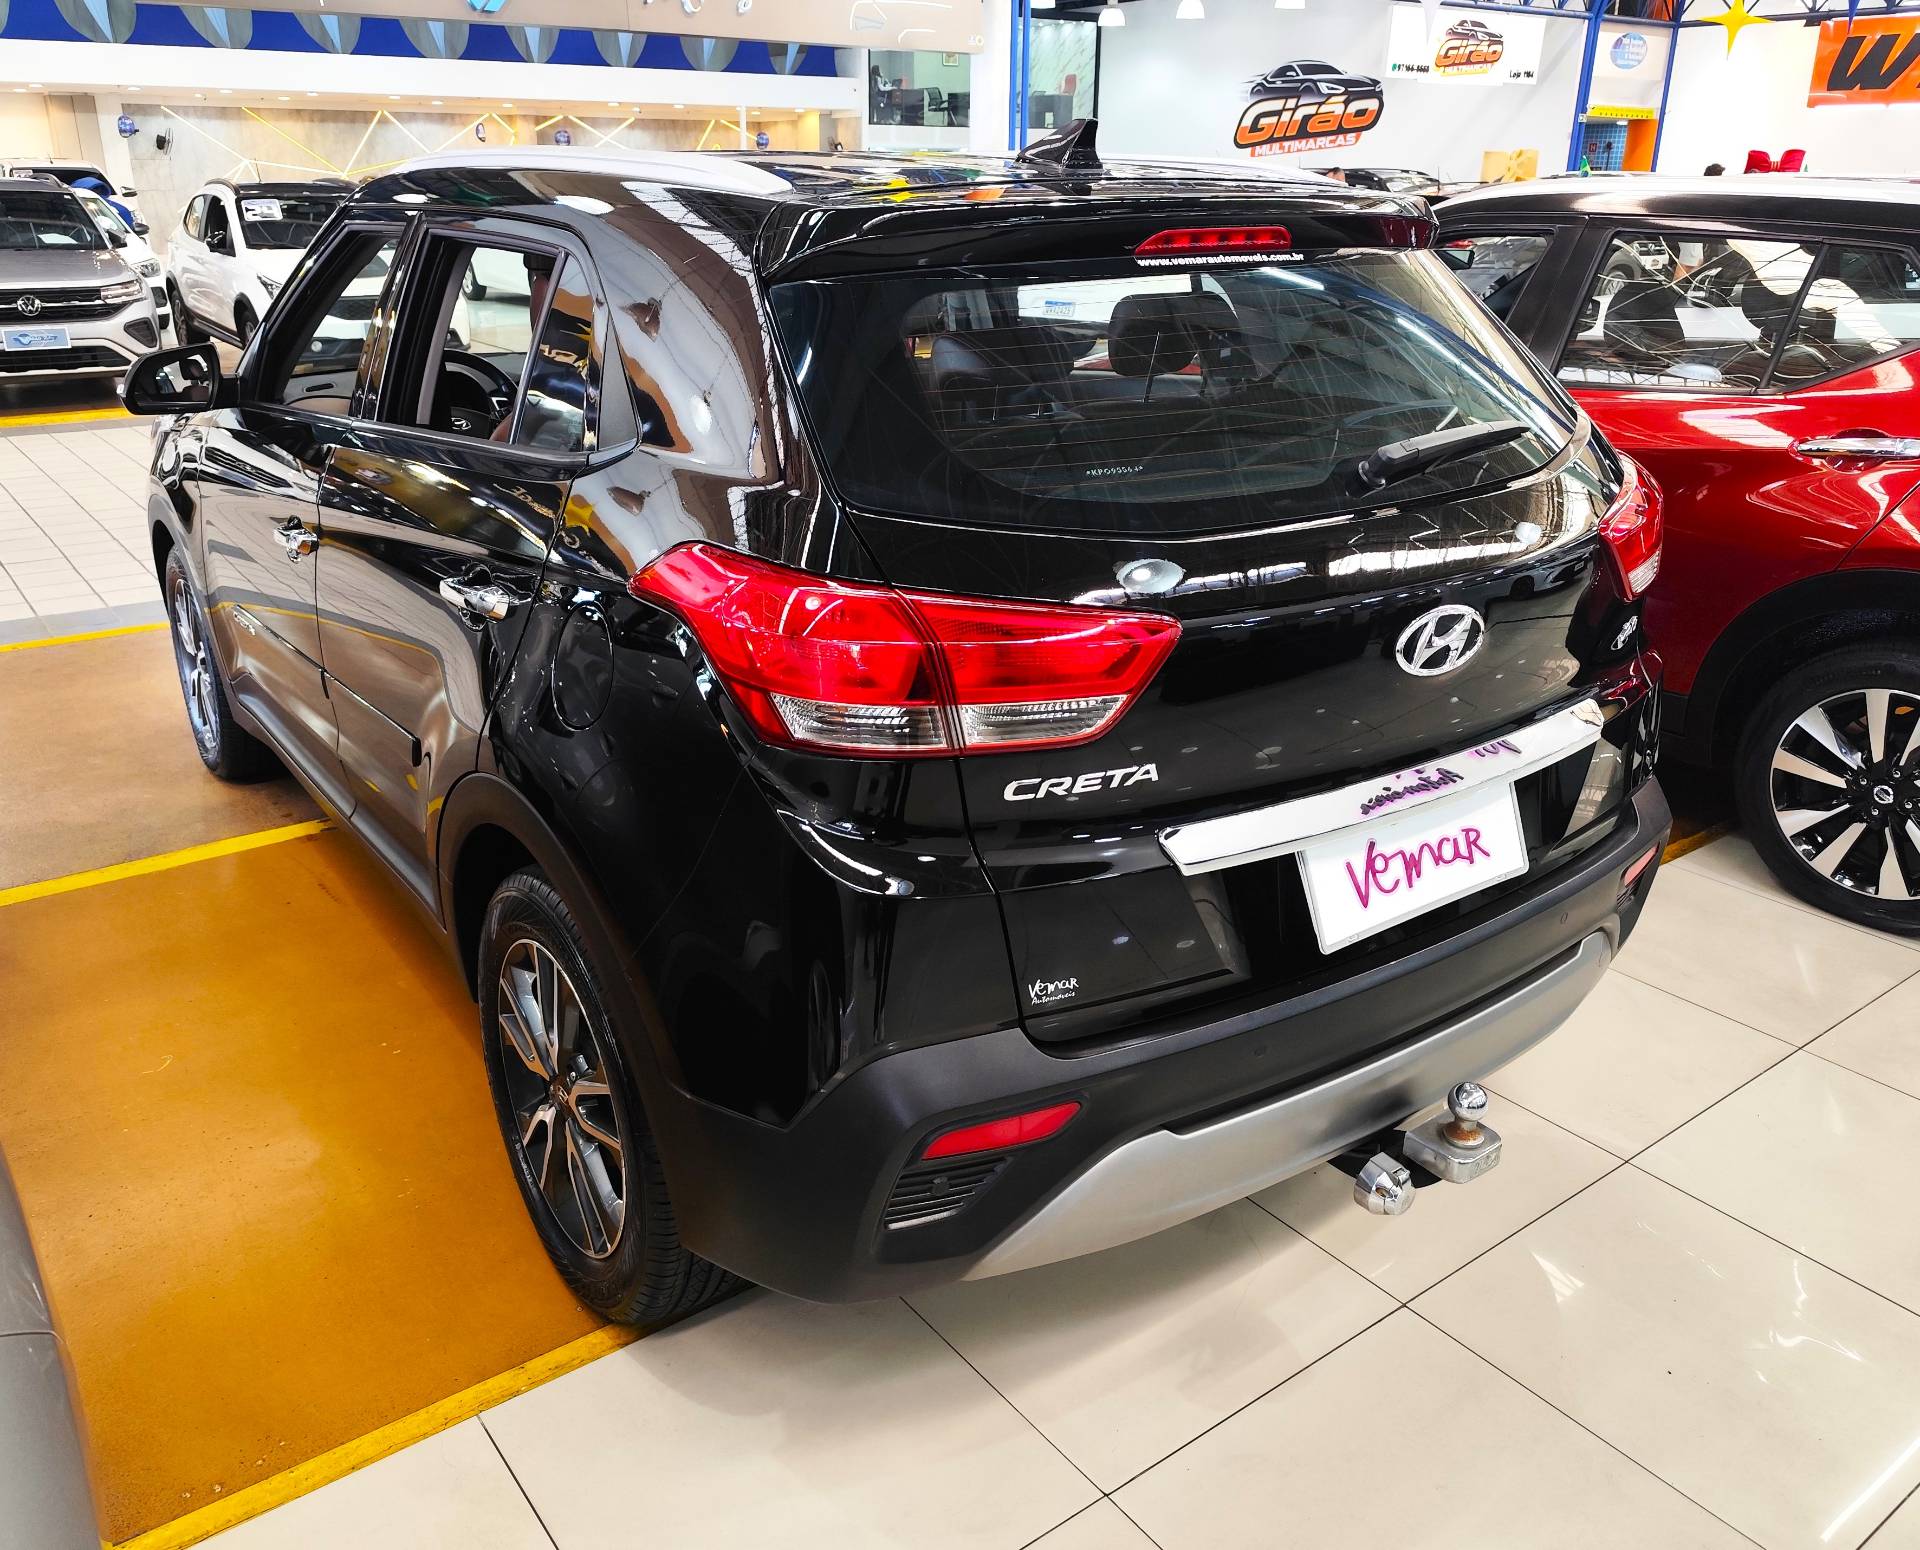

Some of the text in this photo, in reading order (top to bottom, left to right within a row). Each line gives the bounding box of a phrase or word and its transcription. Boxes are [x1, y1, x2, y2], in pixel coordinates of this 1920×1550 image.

[1254, 133, 1357, 157] MULTIMARCAS
[1137, 253, 1305, 267] www.vemarautomoveis.com.br
[1003, 763, 1159, 801] CRETA
